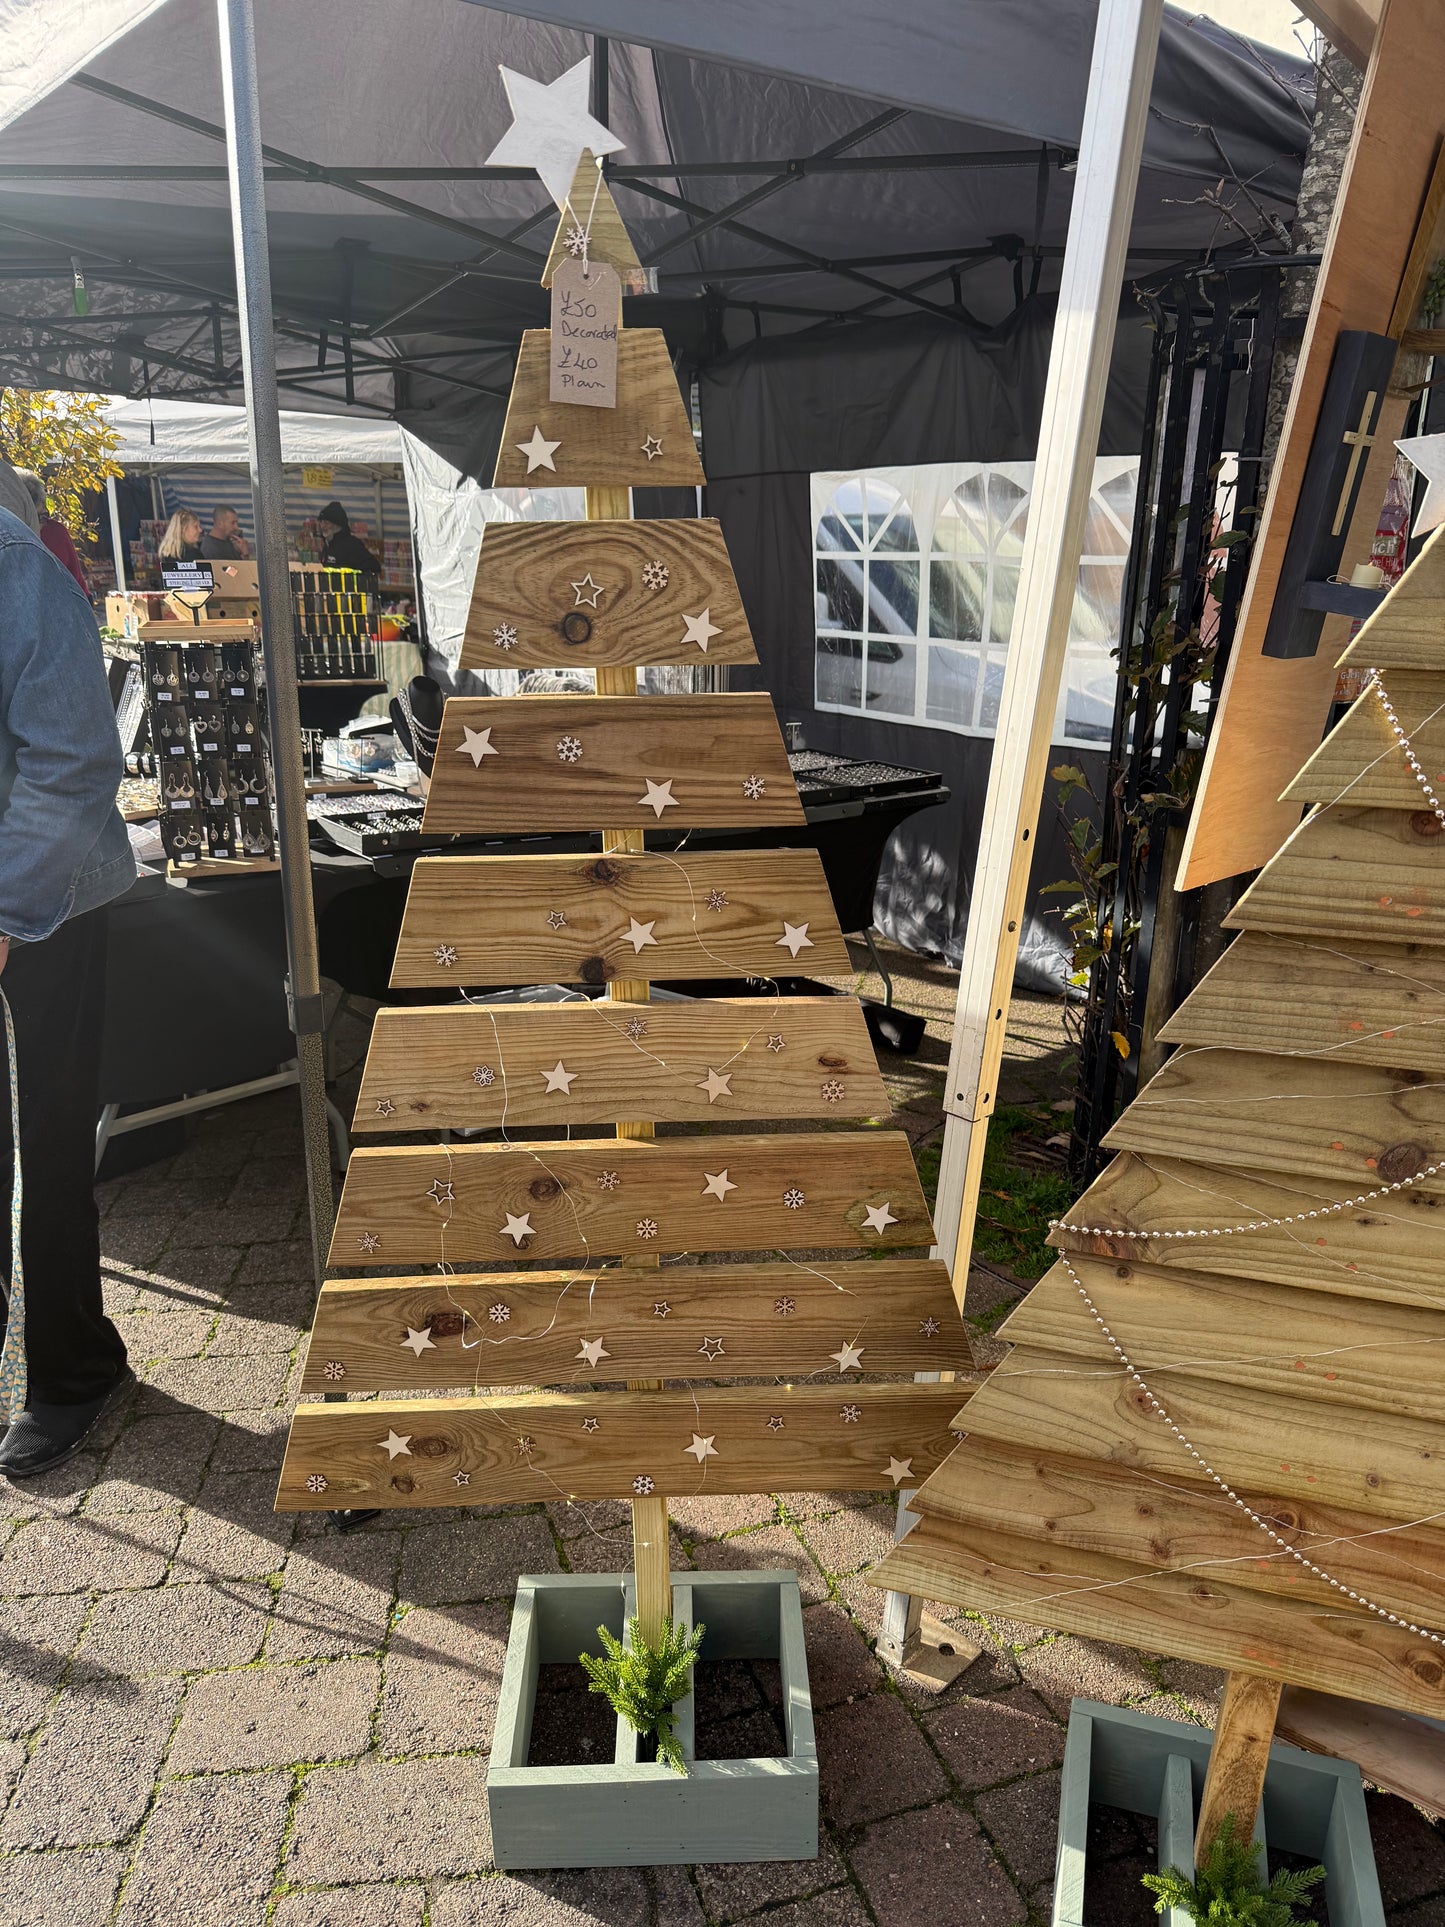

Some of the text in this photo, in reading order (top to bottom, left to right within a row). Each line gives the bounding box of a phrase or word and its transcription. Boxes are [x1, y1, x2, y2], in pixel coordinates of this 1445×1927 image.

[560, 290, 597, 318] £50
[561, 320, 617, 342] Decorated
[557, 345, 598, 370] £40
[561, 373, 606, 389] Plain
